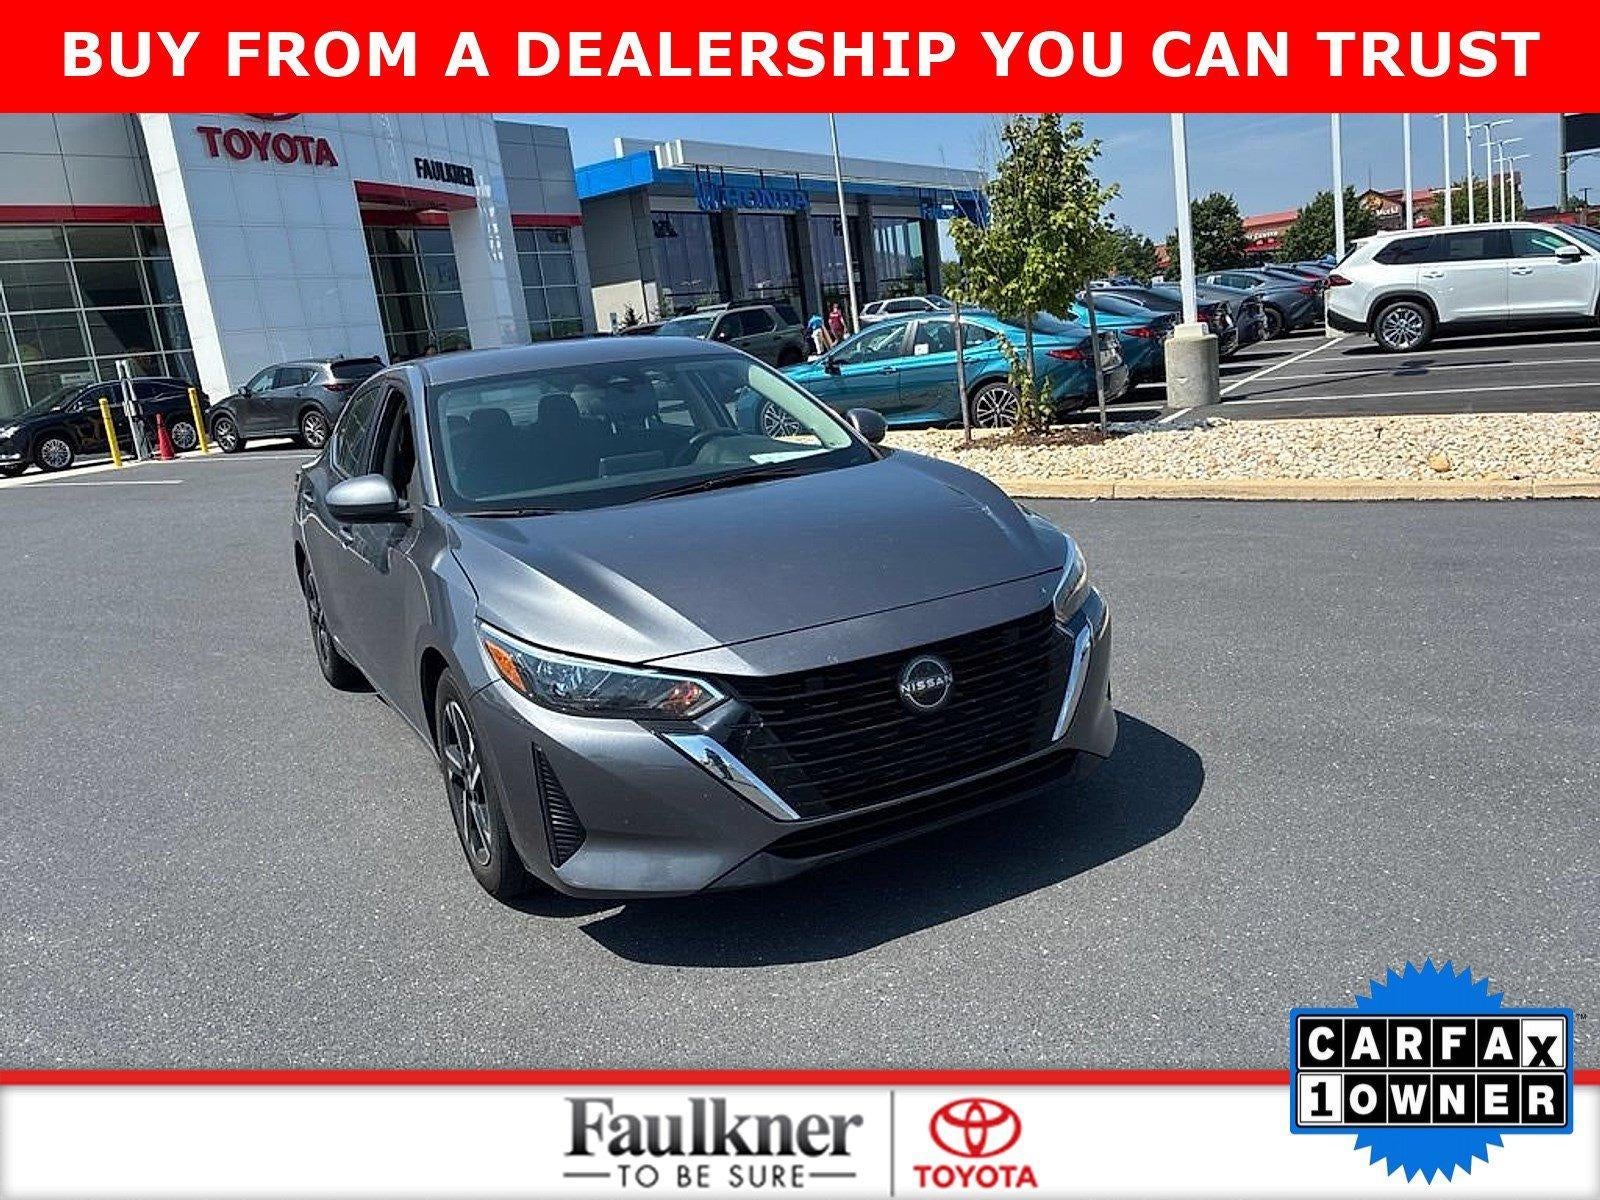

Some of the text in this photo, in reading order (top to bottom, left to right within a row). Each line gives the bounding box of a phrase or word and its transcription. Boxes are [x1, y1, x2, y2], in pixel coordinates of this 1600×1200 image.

[196, 126, 338, 166] TOYOTA
[414, 157, 475, 187] FAULKNER
[900, 673, 953, 693] NISSAN
